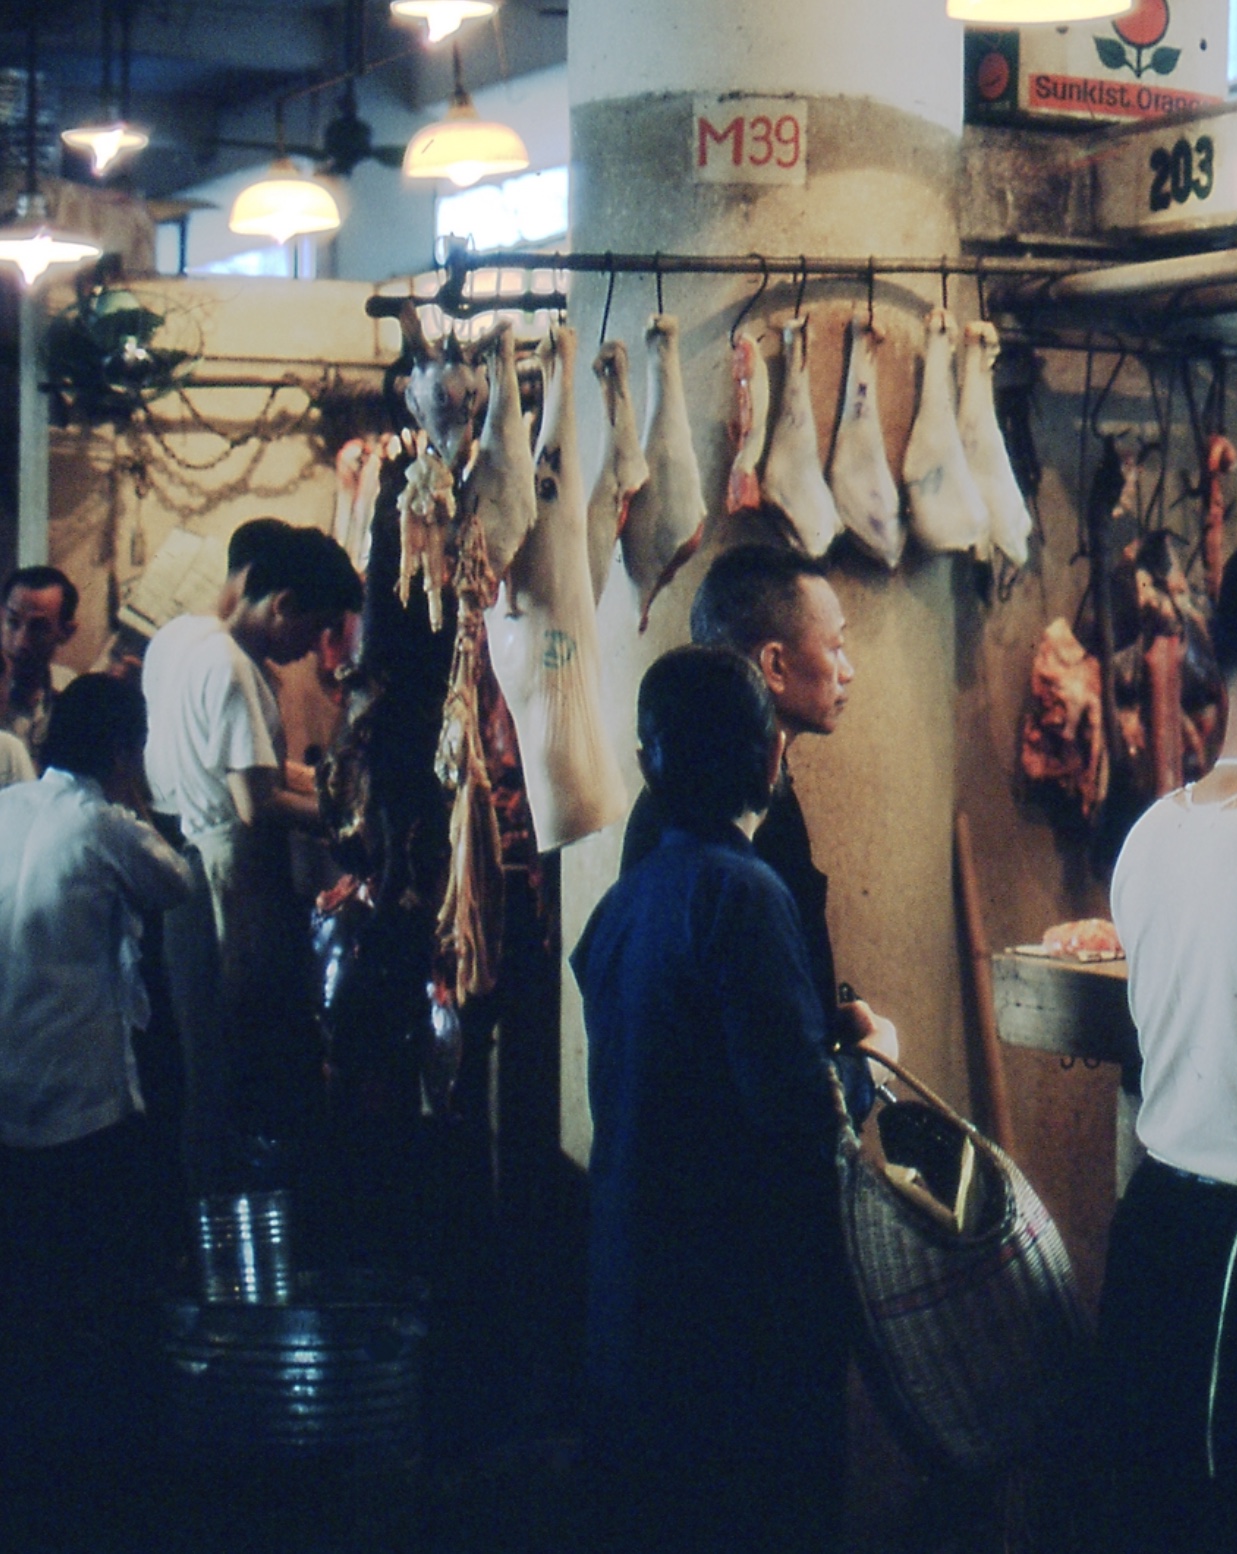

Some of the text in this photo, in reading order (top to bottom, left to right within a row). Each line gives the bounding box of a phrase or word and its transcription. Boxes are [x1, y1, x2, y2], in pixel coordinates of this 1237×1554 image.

[1035, 75, 1131, 108] Sunkist
[698, 114, 800, 169] M39
[1149, 134, 1214, 212] 203
